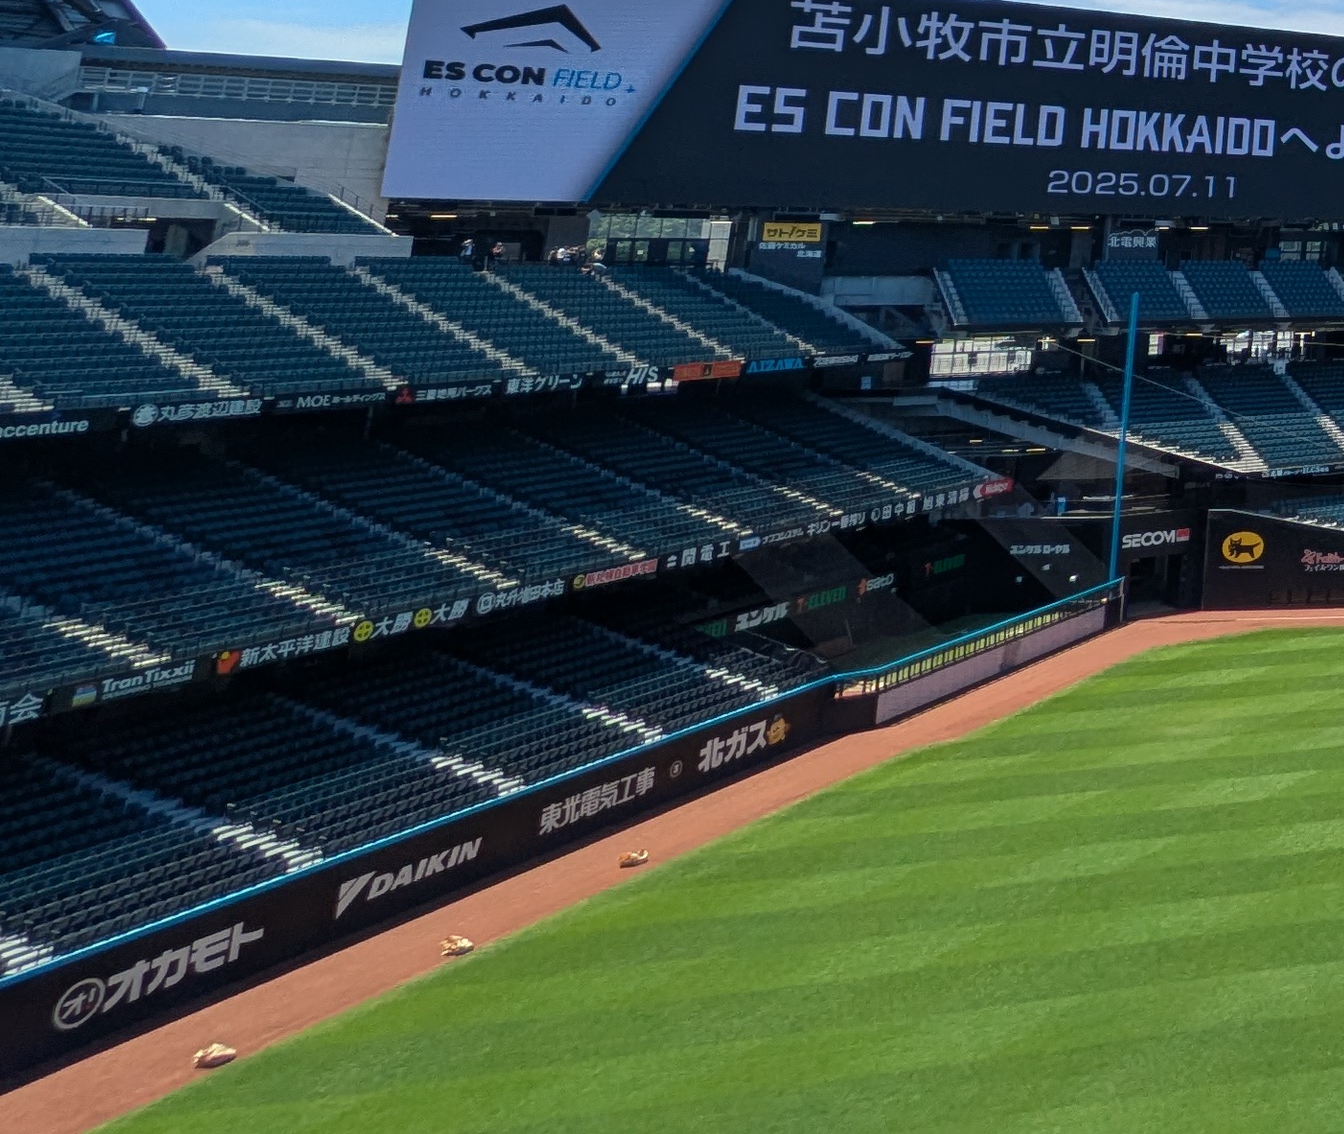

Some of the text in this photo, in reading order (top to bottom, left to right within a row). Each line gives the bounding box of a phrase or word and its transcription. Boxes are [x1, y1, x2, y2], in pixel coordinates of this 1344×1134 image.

[423, 59, 622, 90] ES CON FIELD
[419, 86, 617, 107] HOKKAIDO
[734, 84, 807, 133] ES
[825, 90, 926, 139] CON
[940, 98, 1066, 146] FIELD
[1047, 169, 1238, 198] 2025.07.11
[746, 356, 805, 374] AIZAWA
[506, 373, 583, 395] 東洋グリーン
[158, 399, 262, 423] 丸彦渡辺建設
[1122, 531, 1176, 549] SECOM
[734, 602, 790, 632] ユンケル
[240, 626, 350, 668] 新太平洋建設
[698, 721, 768, 772] 北ガス
[539, 766, 656, 836] 東光電気工事
[367, 837, 483, 899] DAIKIN
[102, 922, 264, 1013] オカモト
